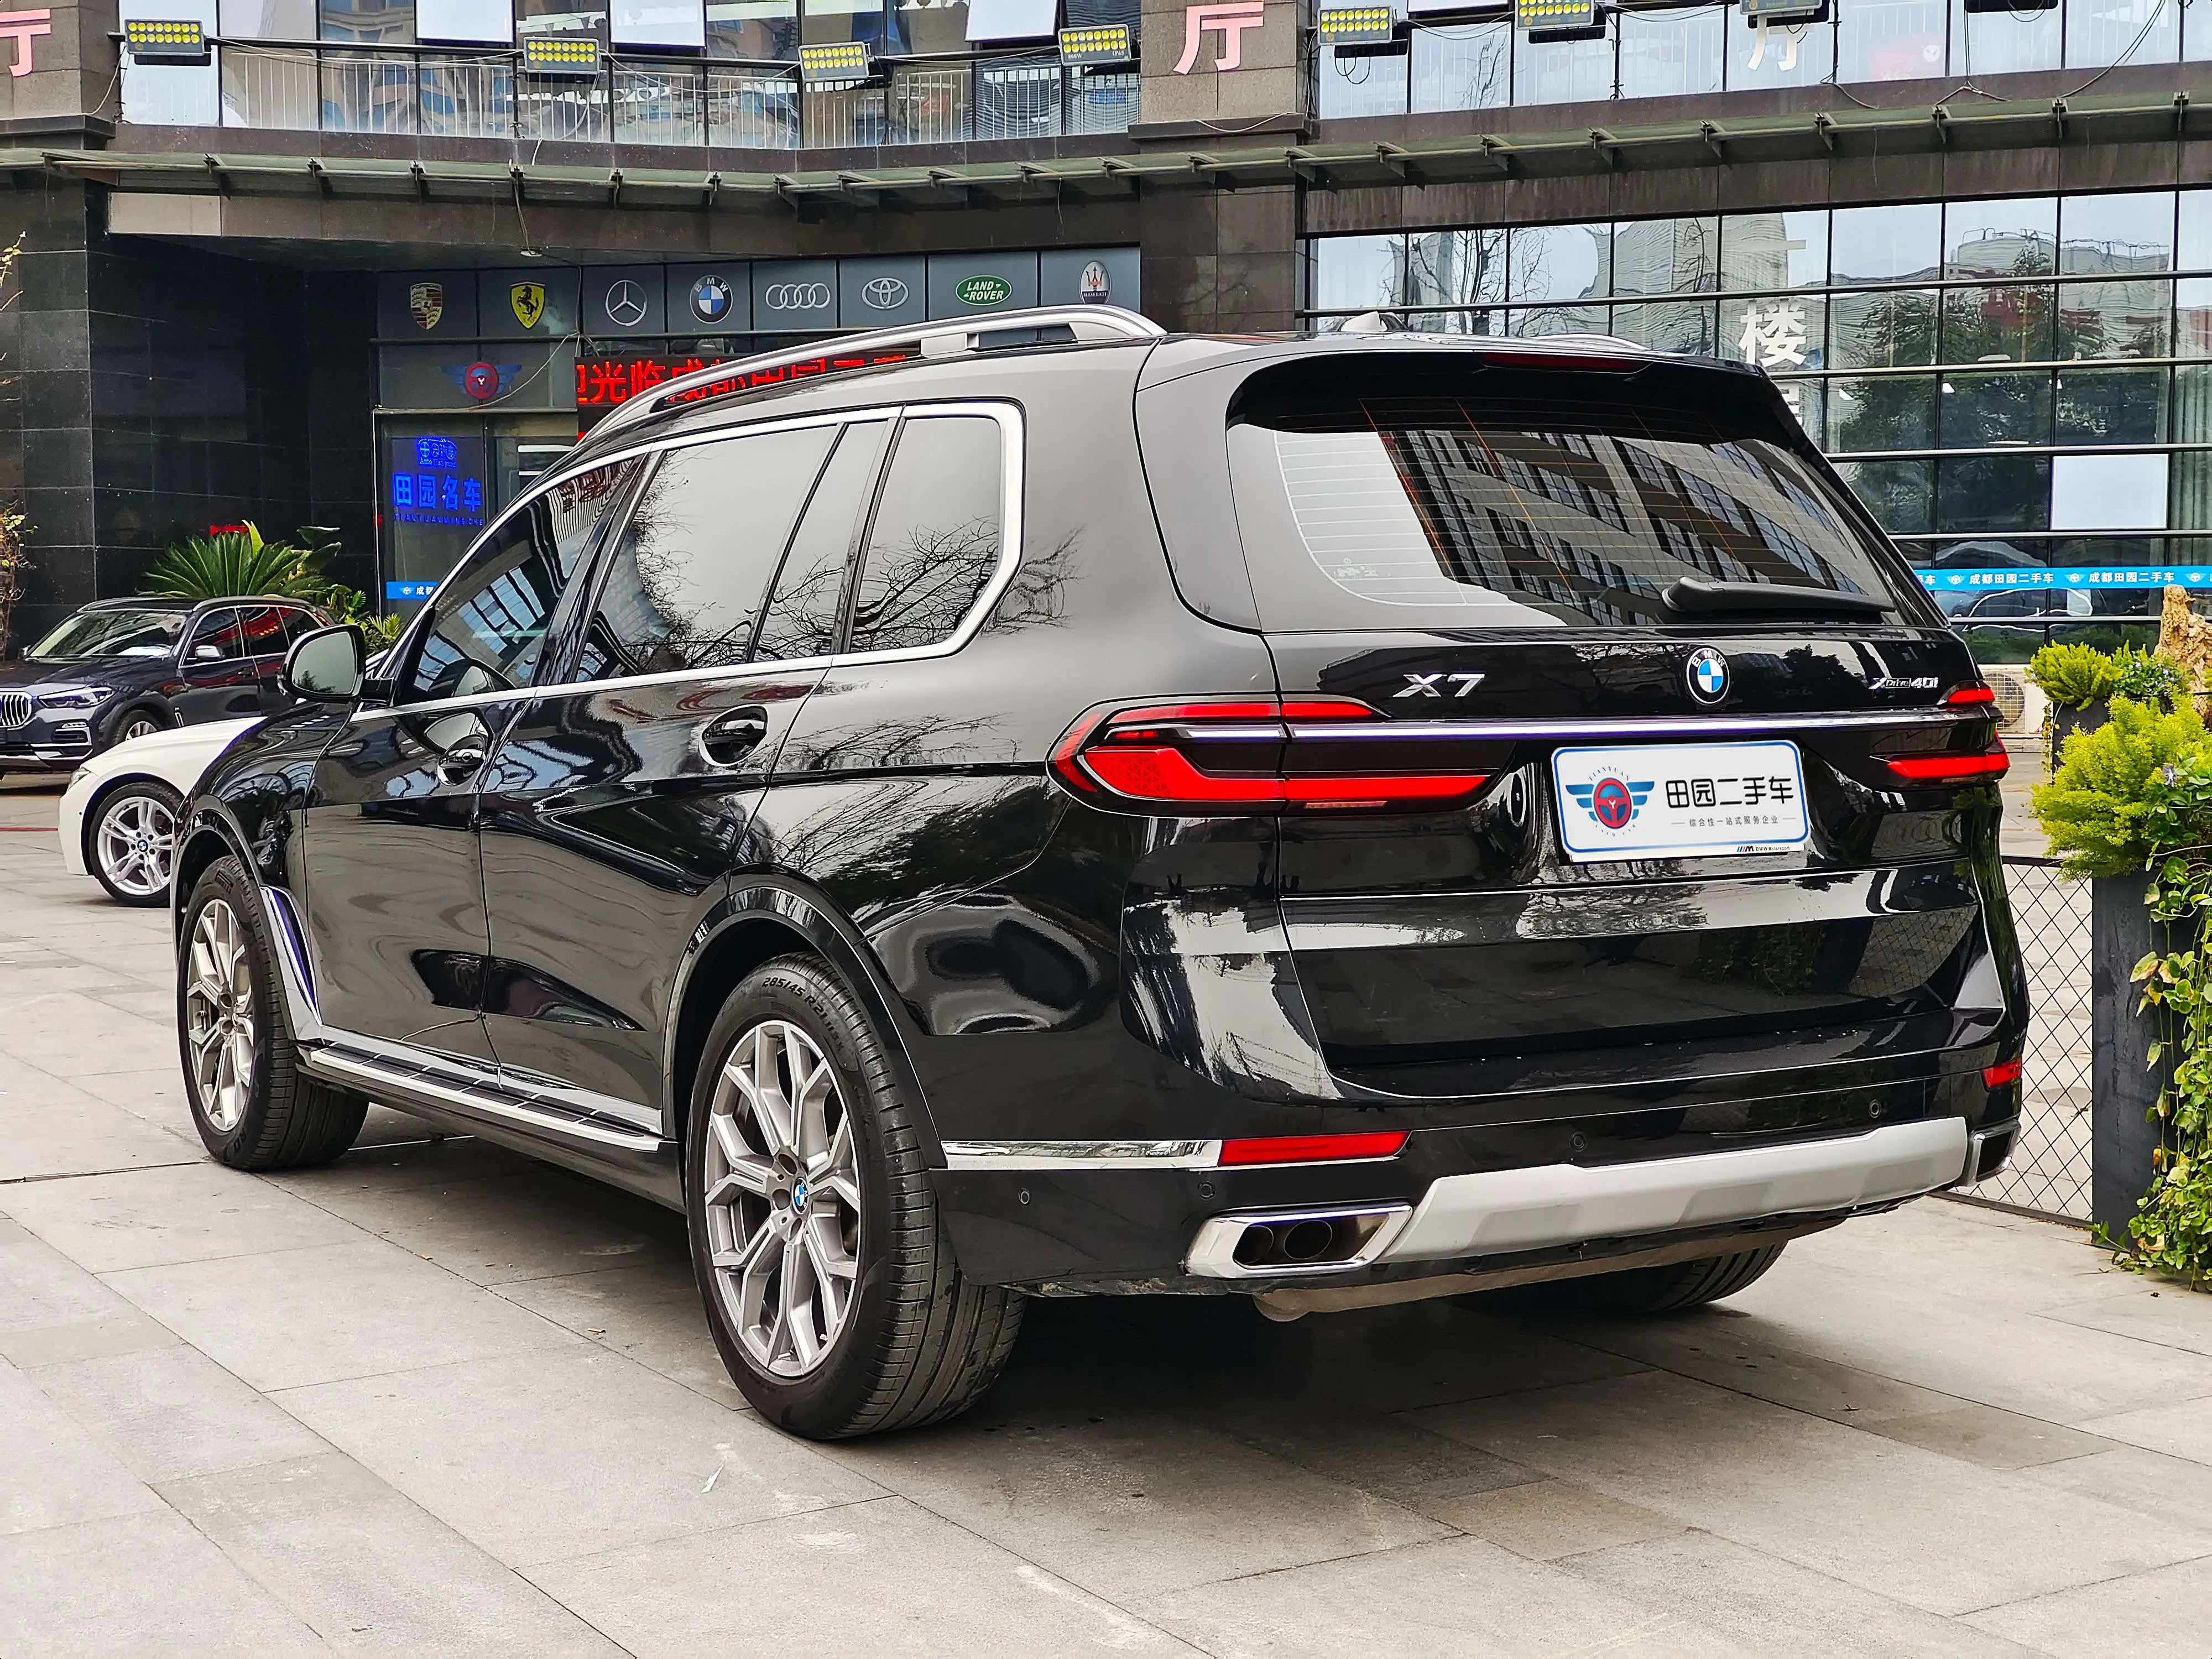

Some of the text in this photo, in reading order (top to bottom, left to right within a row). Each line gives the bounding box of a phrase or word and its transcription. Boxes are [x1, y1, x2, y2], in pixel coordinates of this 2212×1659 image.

[1172, 2, 1264, 75] 厅
[695, 277, 728, 293] BMW
[967, 281, 994, 291] LAND
[969, 290, 1004, 301] ROVER
[395, 474, 482, 512] 田园名车
[1969, 572, 2054, 585] 成都田园二手车
[2088, 571, 2175, 583] 成都田园二手车
[1692, 650, 1725, 667] BMW
[1392, 674, 1485, 697] X7
[1666, 776, 1794, 808] 田园二手车
[1689, 815, 1778, 828] 综合性一站式服务企业
[762, 977, 806, 997] 285/45
[804, 995, 828, 1020] R21
